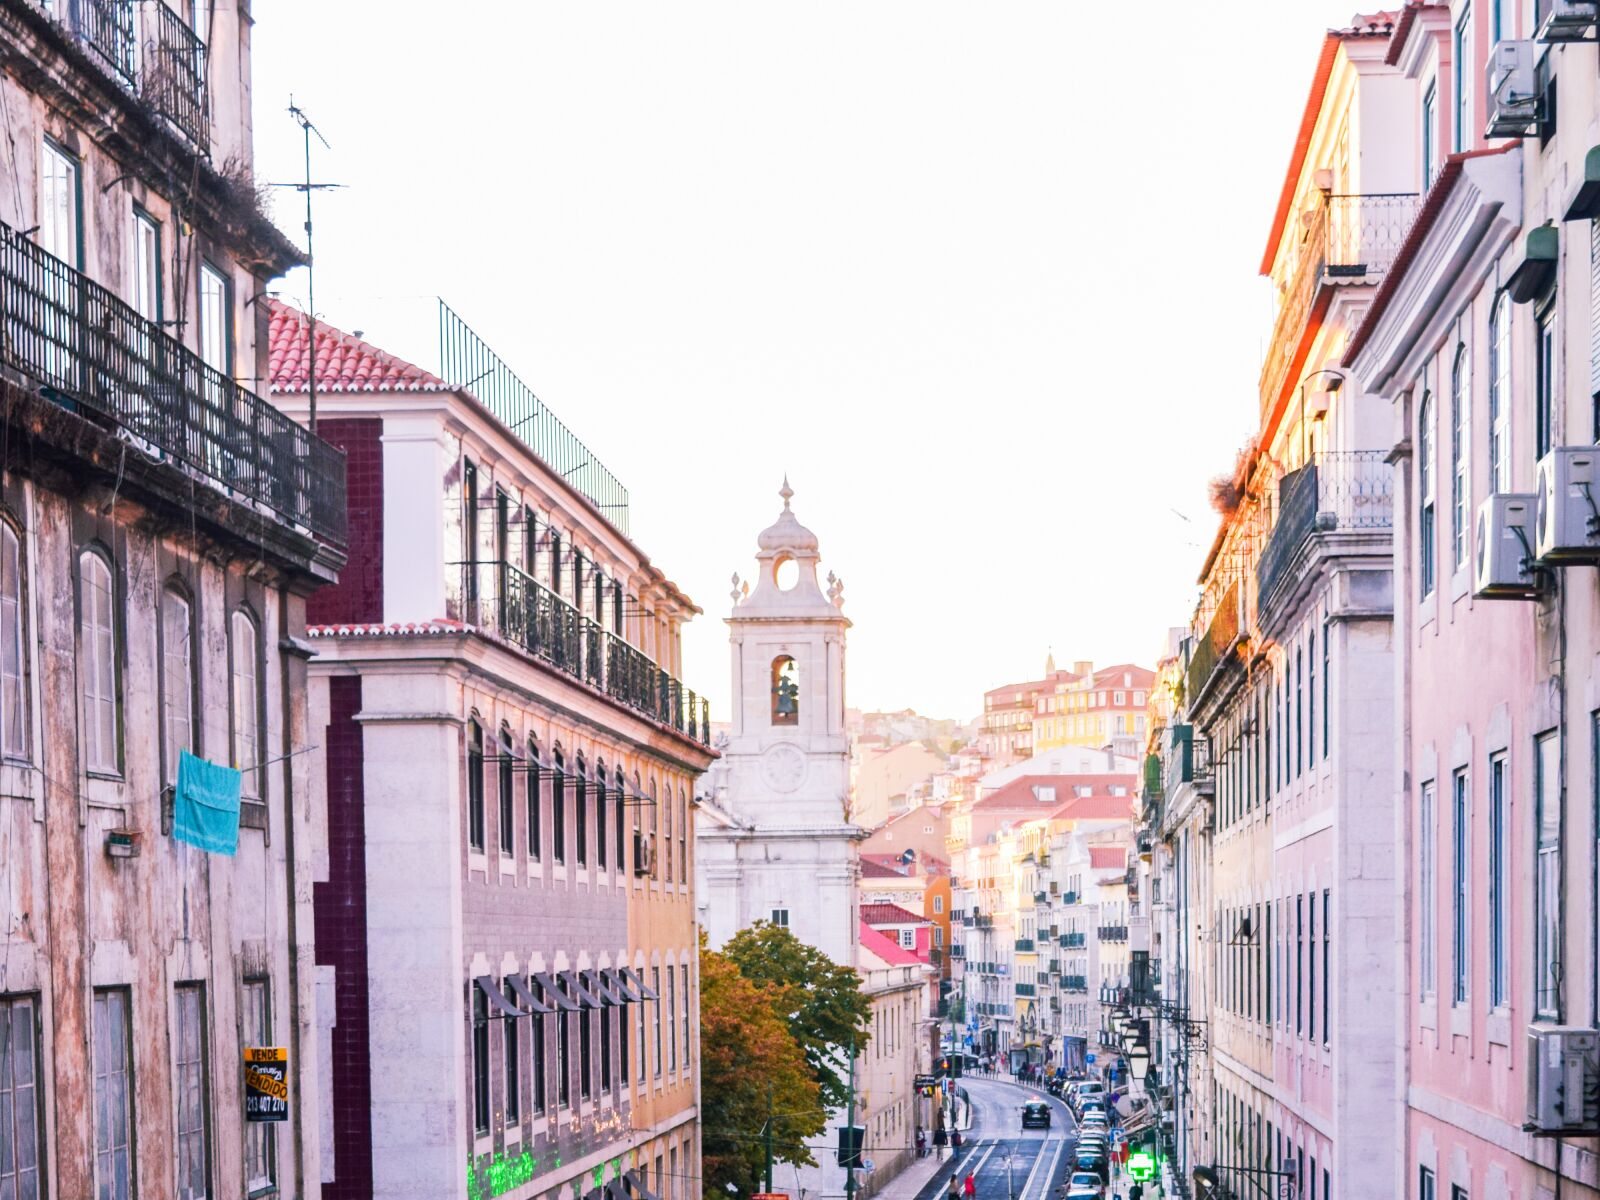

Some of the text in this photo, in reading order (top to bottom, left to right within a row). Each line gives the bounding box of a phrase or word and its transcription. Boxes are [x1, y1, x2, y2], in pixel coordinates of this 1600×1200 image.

[251, 1049, 278, 1060] VENDE
[274, 1070, 282, 1080] 21
[246, 1069, 287, 1099] VENDIDO
[247, 1096, 258, 1112] 213
[260, 1096, 271, 1112] 407
